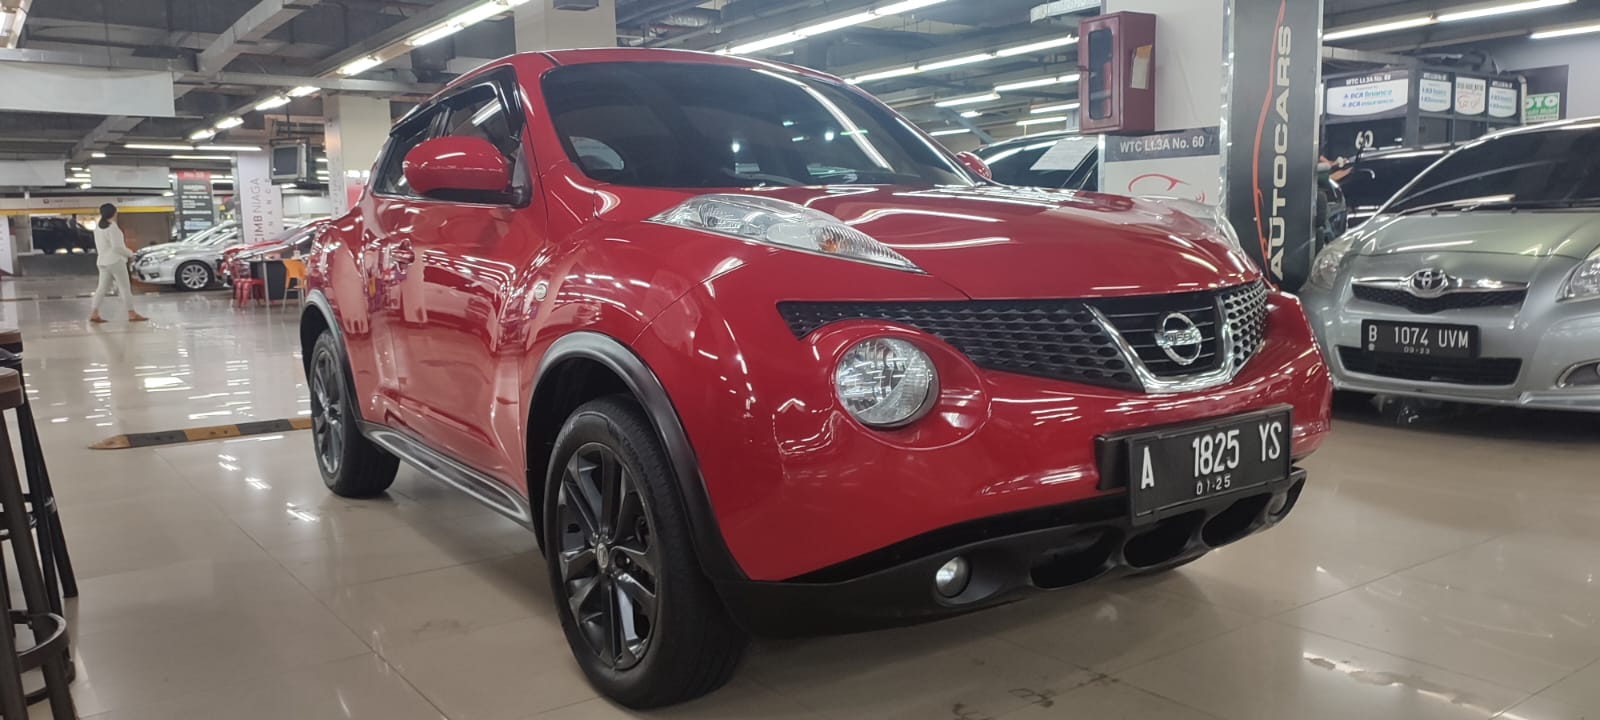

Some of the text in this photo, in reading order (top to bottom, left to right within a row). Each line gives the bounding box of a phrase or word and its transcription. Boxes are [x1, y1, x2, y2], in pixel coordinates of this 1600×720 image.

[1120, 141, 1142, 153] WTC
[1172, 137, 1189, 149] No.
[1192, 135, 1205, 148] 60
[1268, 25, 1292, 281] AUTOCARS
[249, 176, 265, 243] CIMB NIAGA
[1368, 324, 1468, 348] B 1074 UVM
[1140, 421, 1282, 489] A 1825 YS
